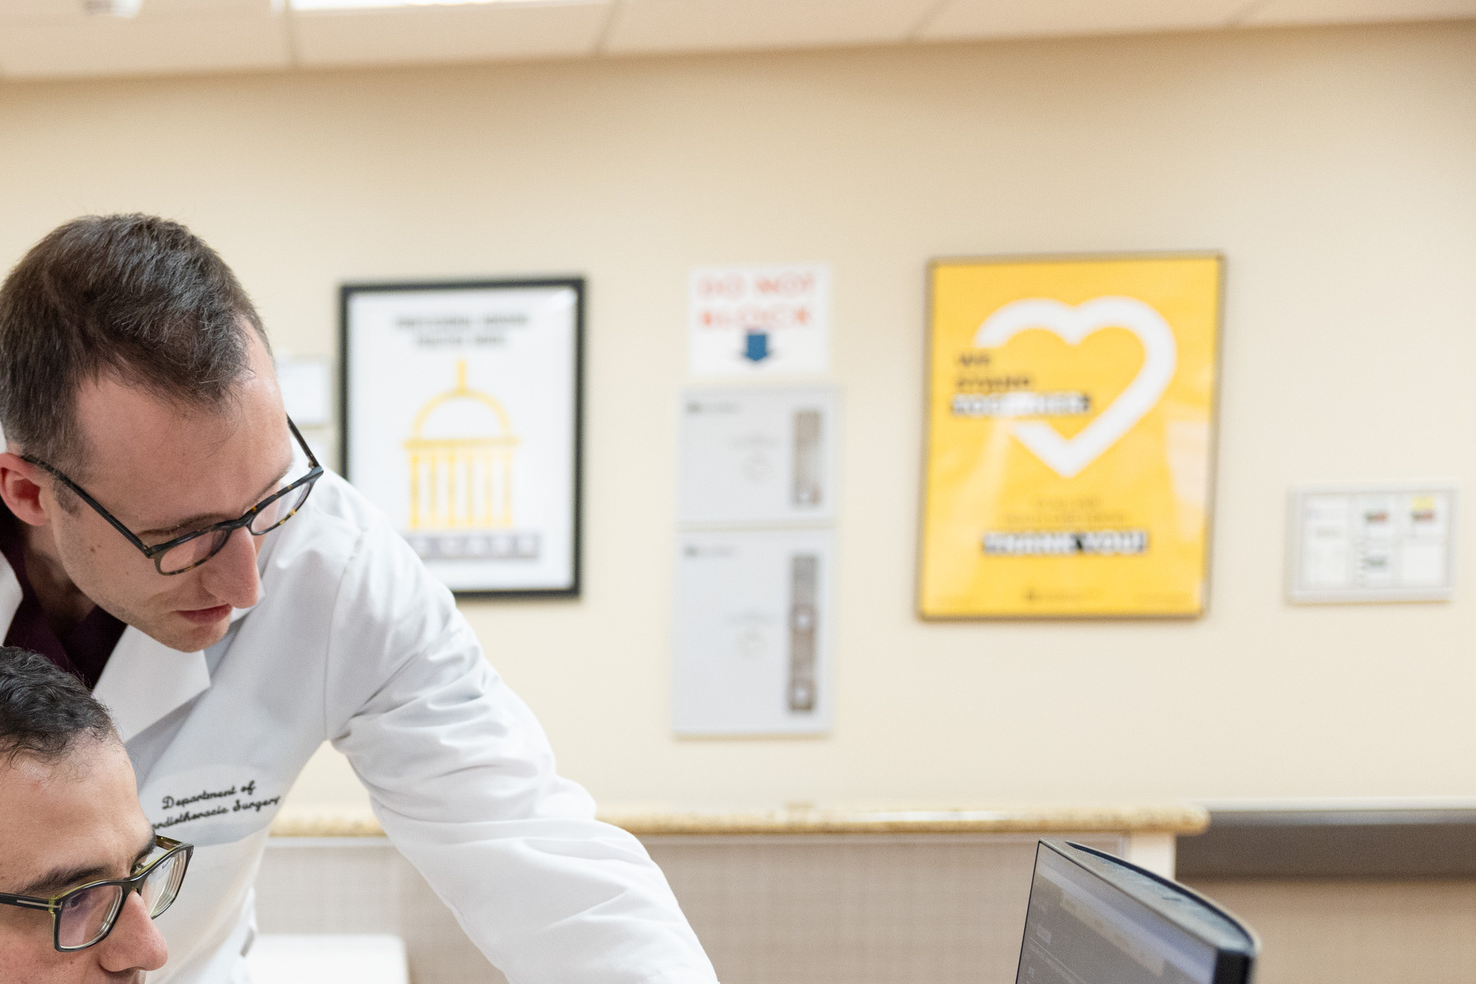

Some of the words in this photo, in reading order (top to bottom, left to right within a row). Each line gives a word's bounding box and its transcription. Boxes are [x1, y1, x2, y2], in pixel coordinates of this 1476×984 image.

[161, 785, 236, 810] Department
[240, 780, 255, 795] of
[152, 805, 228, 830] ardiothoracic
[232, 796, 281, 812] Surgery
